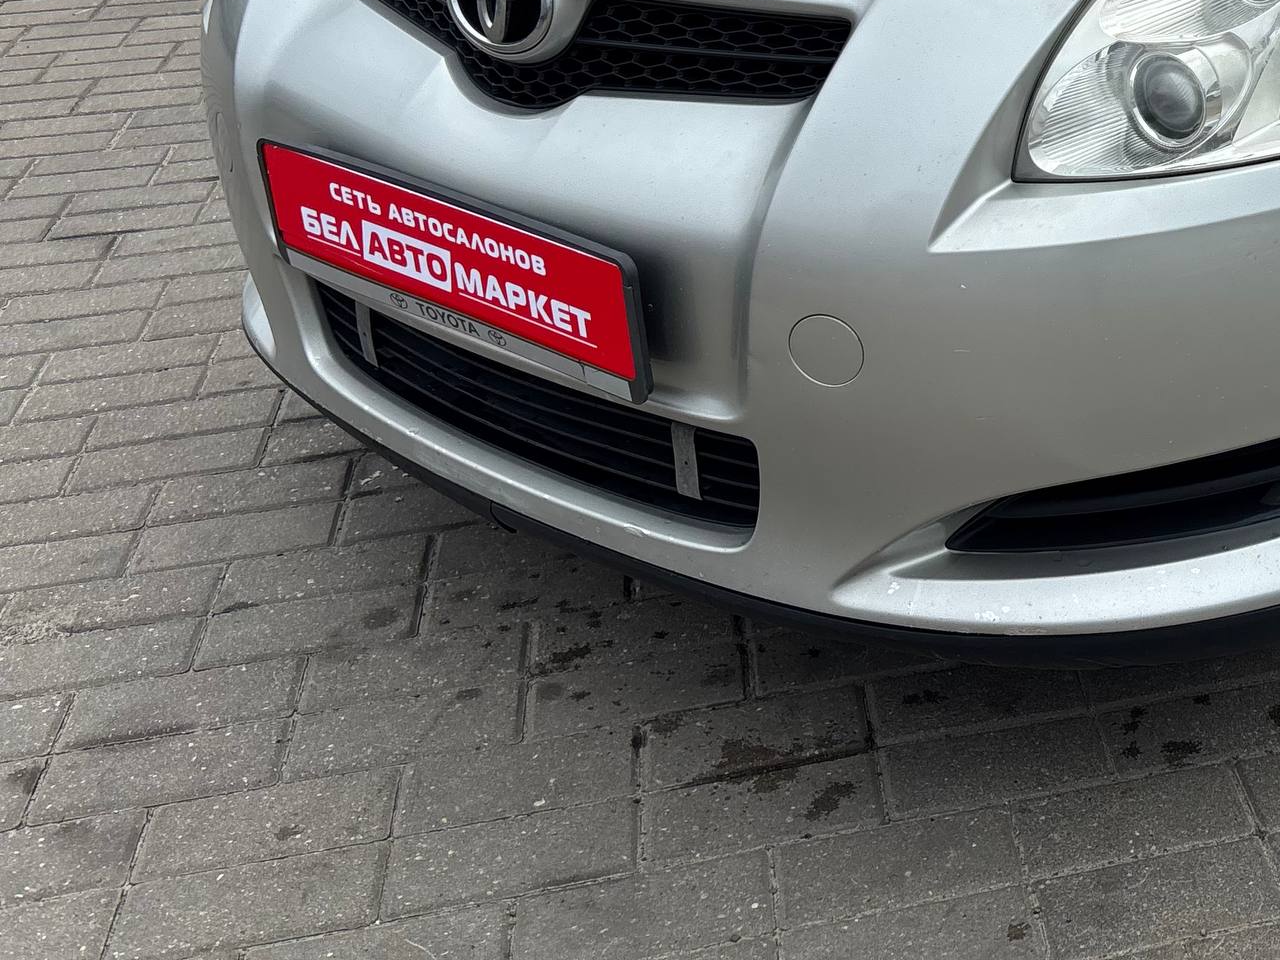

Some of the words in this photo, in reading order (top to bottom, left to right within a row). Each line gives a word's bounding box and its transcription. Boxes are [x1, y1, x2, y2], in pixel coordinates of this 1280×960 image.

[329, 182, 381, 216] СЕТЬ
[388, 203, 547, 276] АВТОСАЛОНОВ
[415, 301, 480, 337] TOYOTA
